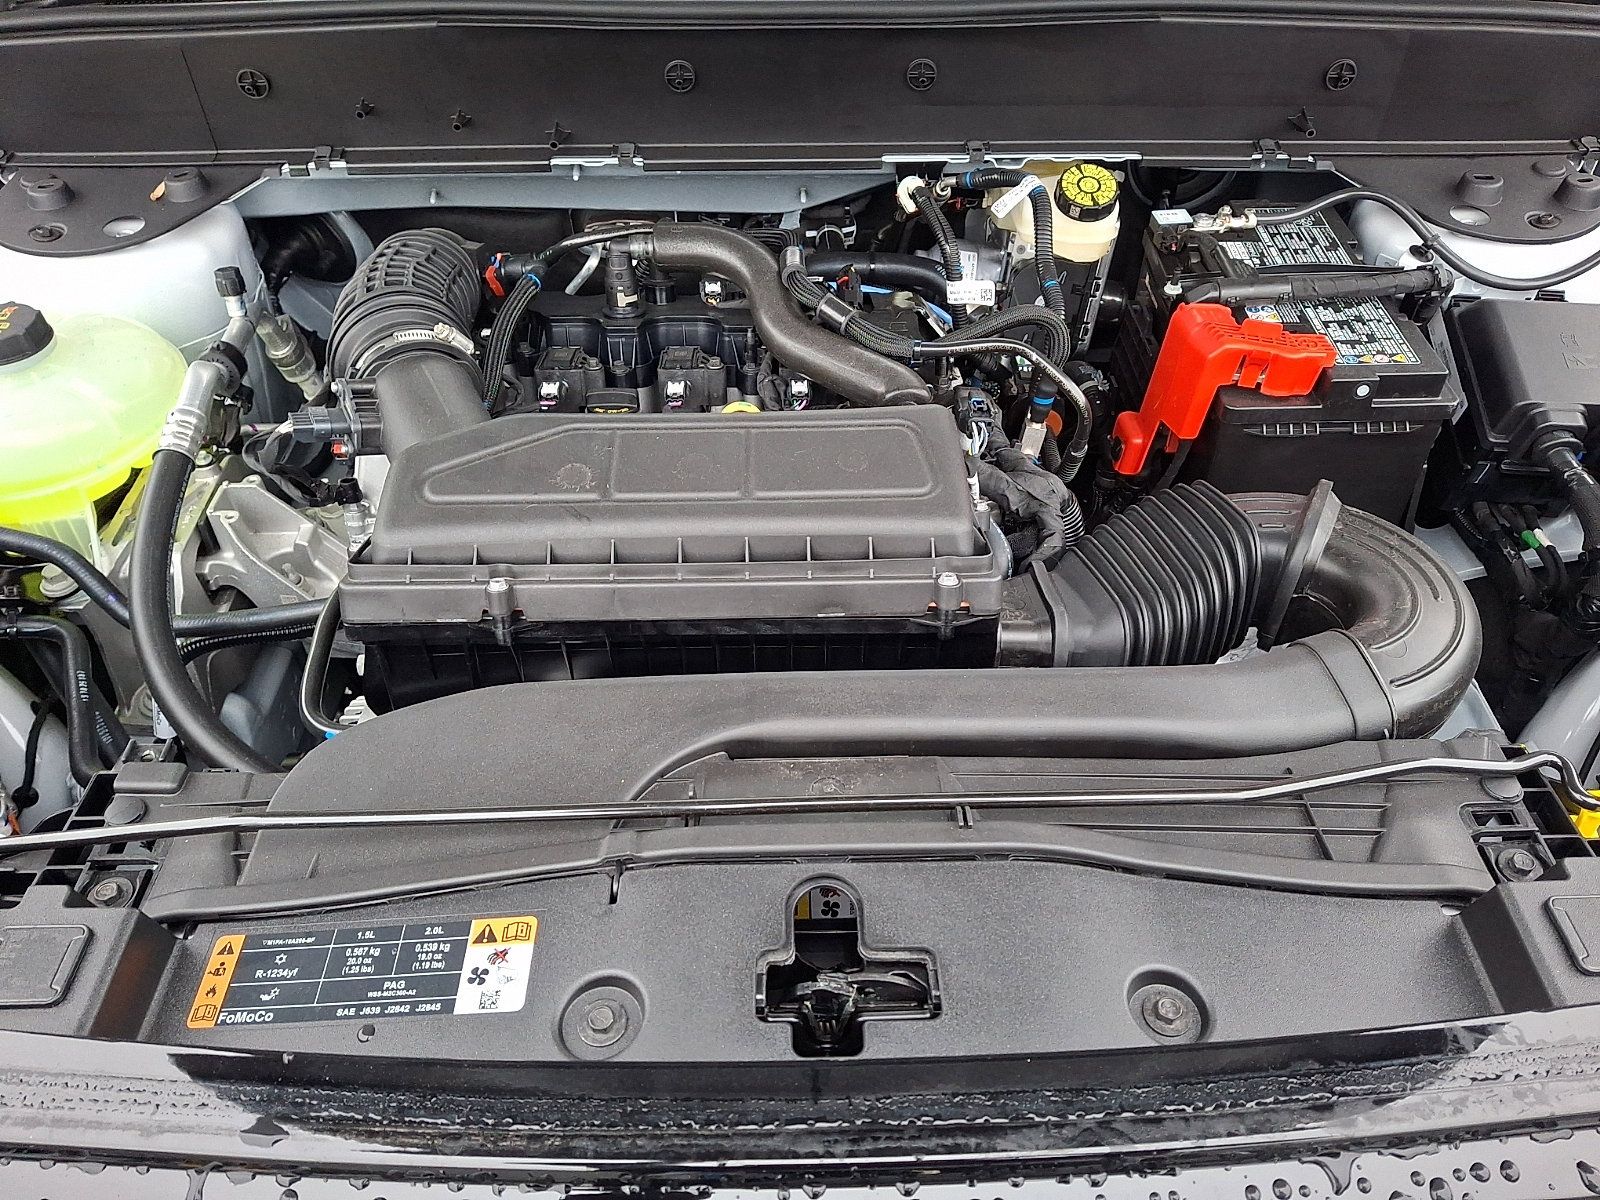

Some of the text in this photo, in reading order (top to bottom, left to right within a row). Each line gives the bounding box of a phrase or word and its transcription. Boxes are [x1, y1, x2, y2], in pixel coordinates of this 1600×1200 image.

[357, 931, 375, 940] 1.5L
[424, 926, 444, 935] 2.0L
[369, 947, 381, 957] kg
[438, 942, 450, 952] kg
[346, 957, 361, 965] 20.0
[433, 952, 442, 960] oz
[360, 964, 375, 974] lbs)
[430, 960, 445, 970] lbs)
[254, 968, 299, 979] R-1234yf
[383, 980, 406, 990] PAG
[336, 1007, 356, 1017] SAE
[359, 1006, 381, 1016] J639
[217, 1010, 274, 1025] FoMoCo
